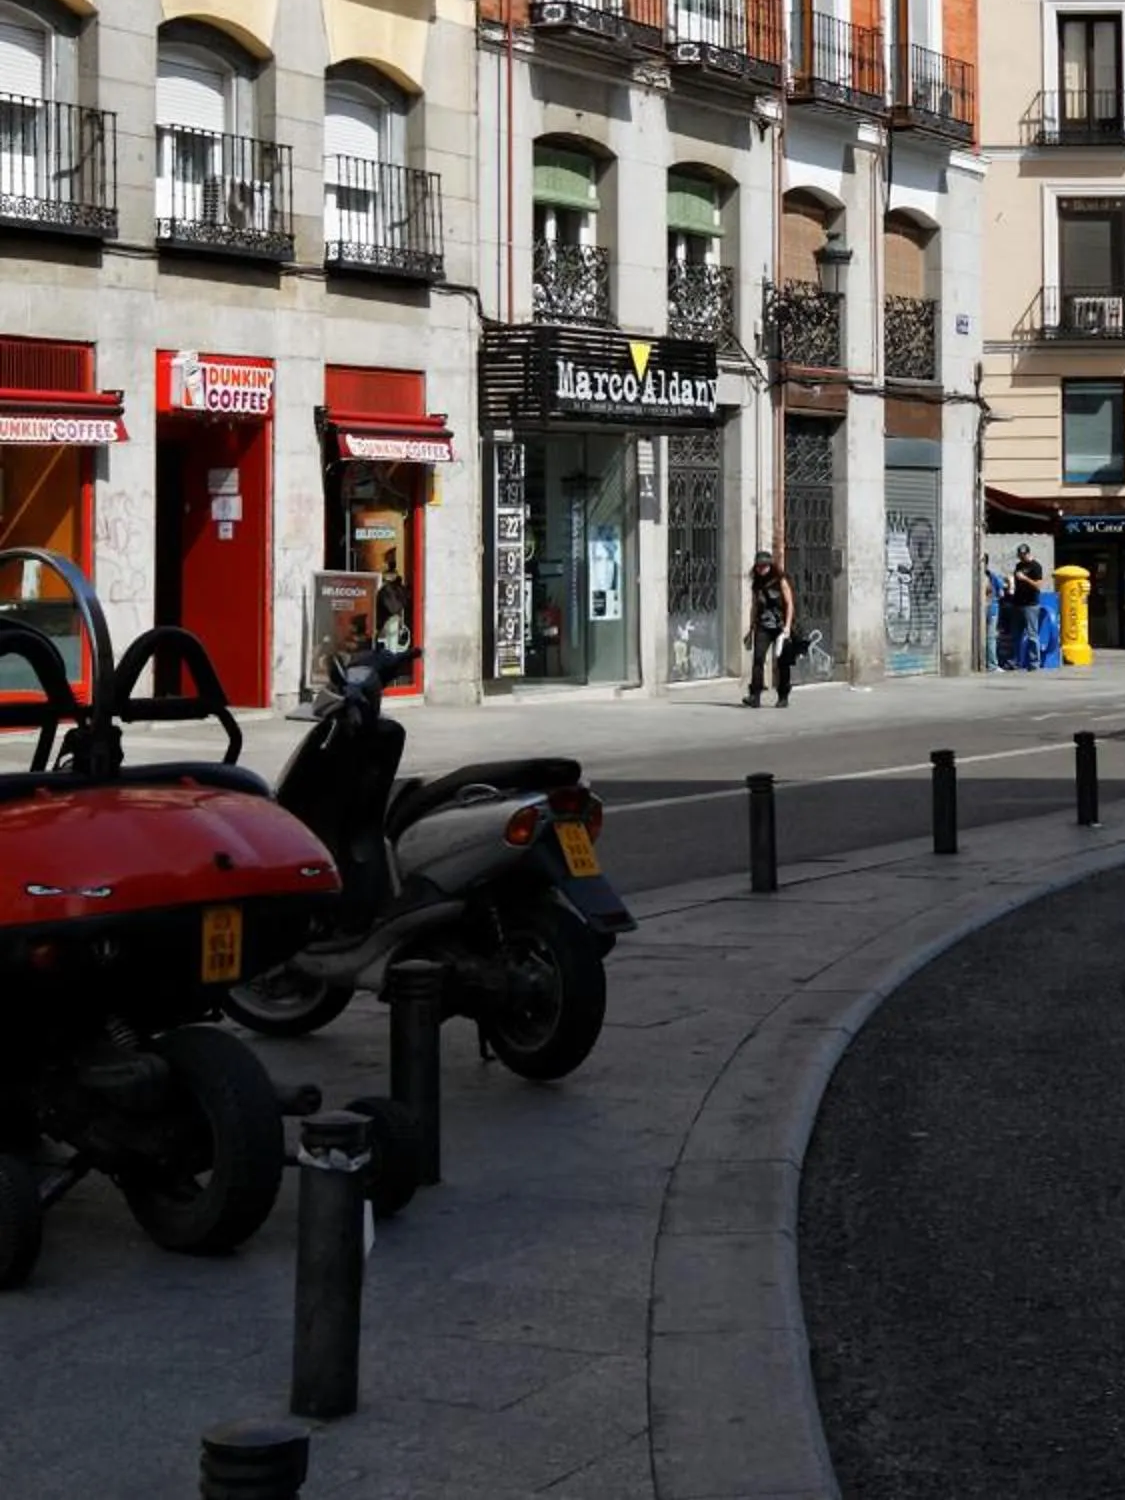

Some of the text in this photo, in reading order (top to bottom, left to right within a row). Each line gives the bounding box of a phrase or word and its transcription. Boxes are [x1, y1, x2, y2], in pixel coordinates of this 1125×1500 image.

[208, 366, 272, 386] DUNKIN'
[556, 361, 719, 413] Marco Aldany
[207, 389, 267, 410] COFFEE
[54, 421, 112, 439] COFFEE
